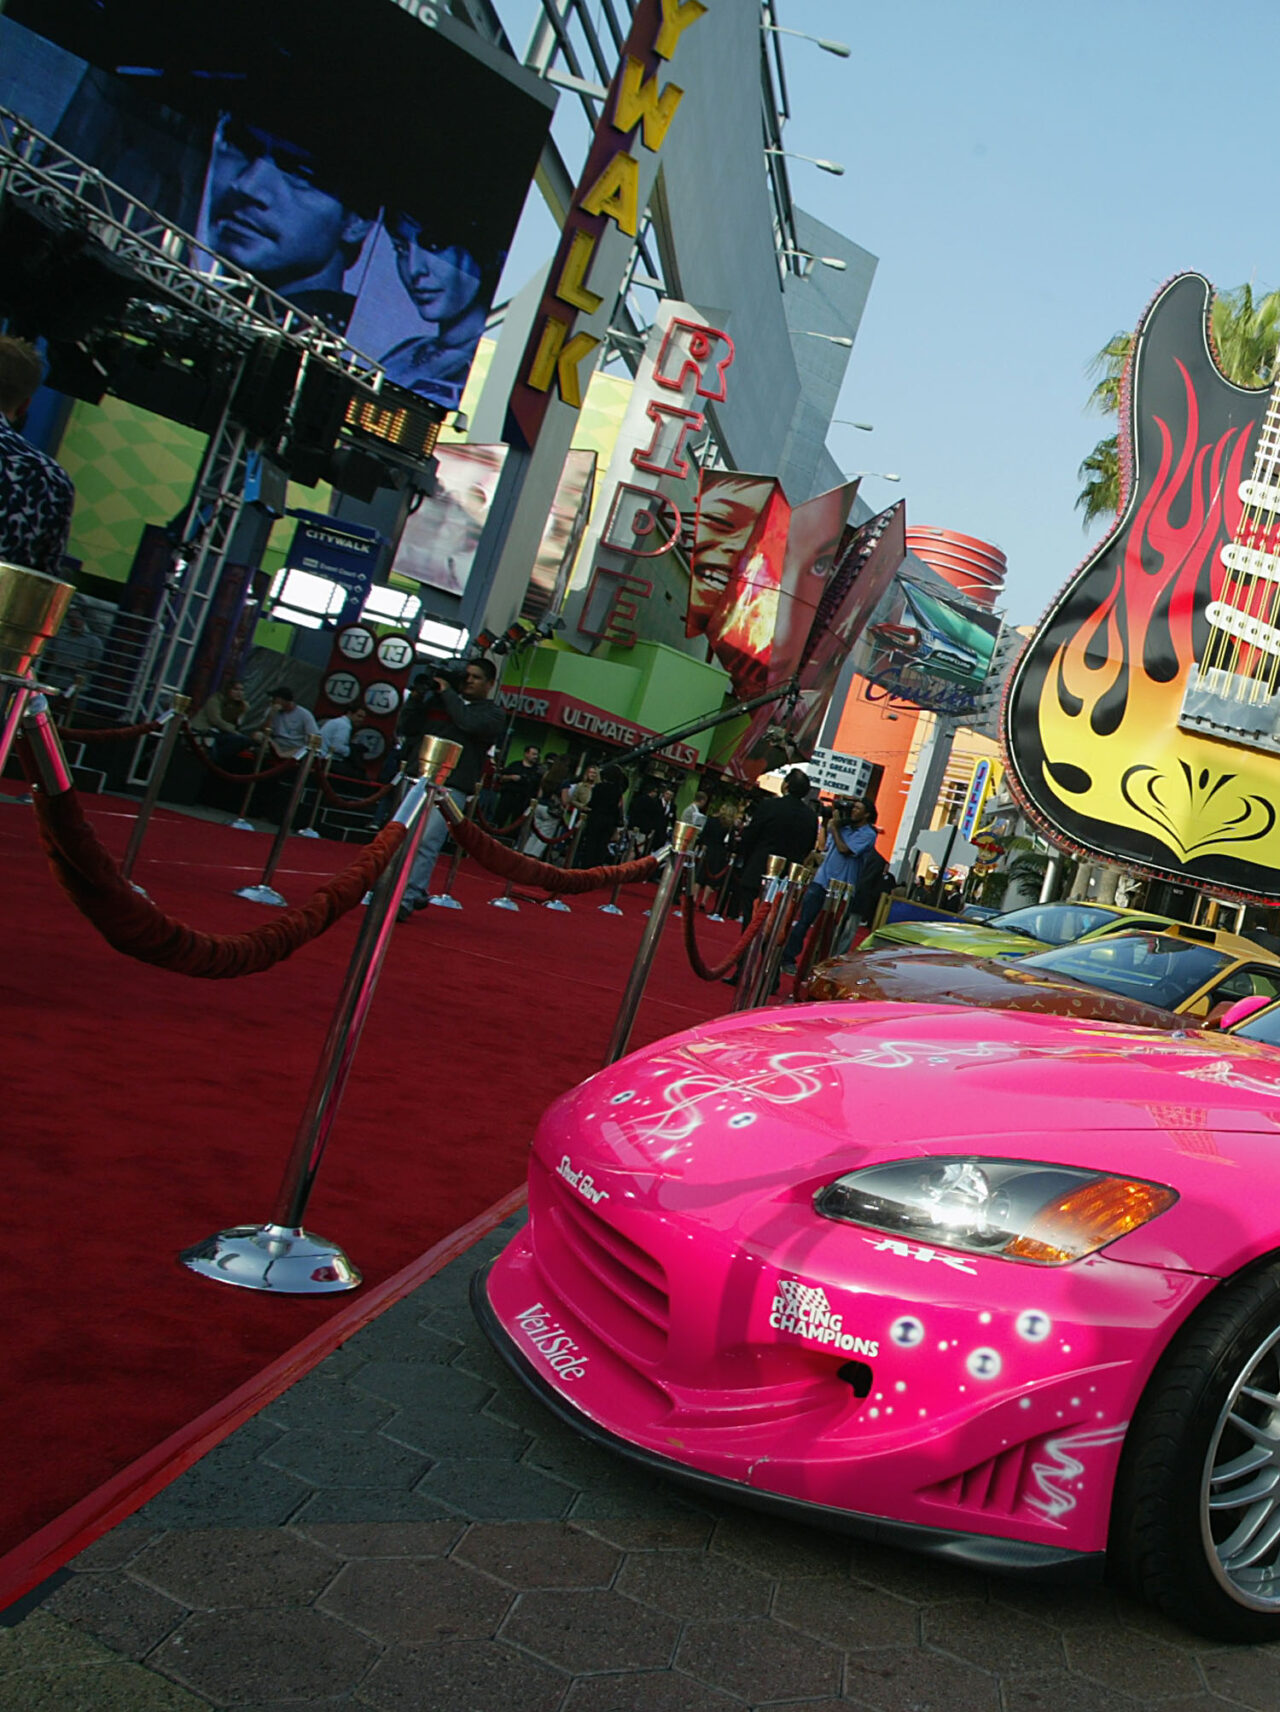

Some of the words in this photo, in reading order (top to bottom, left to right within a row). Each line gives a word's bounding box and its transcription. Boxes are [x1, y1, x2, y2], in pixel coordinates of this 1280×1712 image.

[577, 316, 736, 648] RIDE
[305, 529, 371, 554] CITYWALK
[562, 706, 638, 746] ULTIMATE
[823, 779, 851, 792] SCREEN
[829, 762, 857, 776] GREASE
[771, 1295, 844, 1331] RACING
[514, 1302, 590, 1382] VeilSide
[768, 1311, 880, 1358] CHAMPIONS
